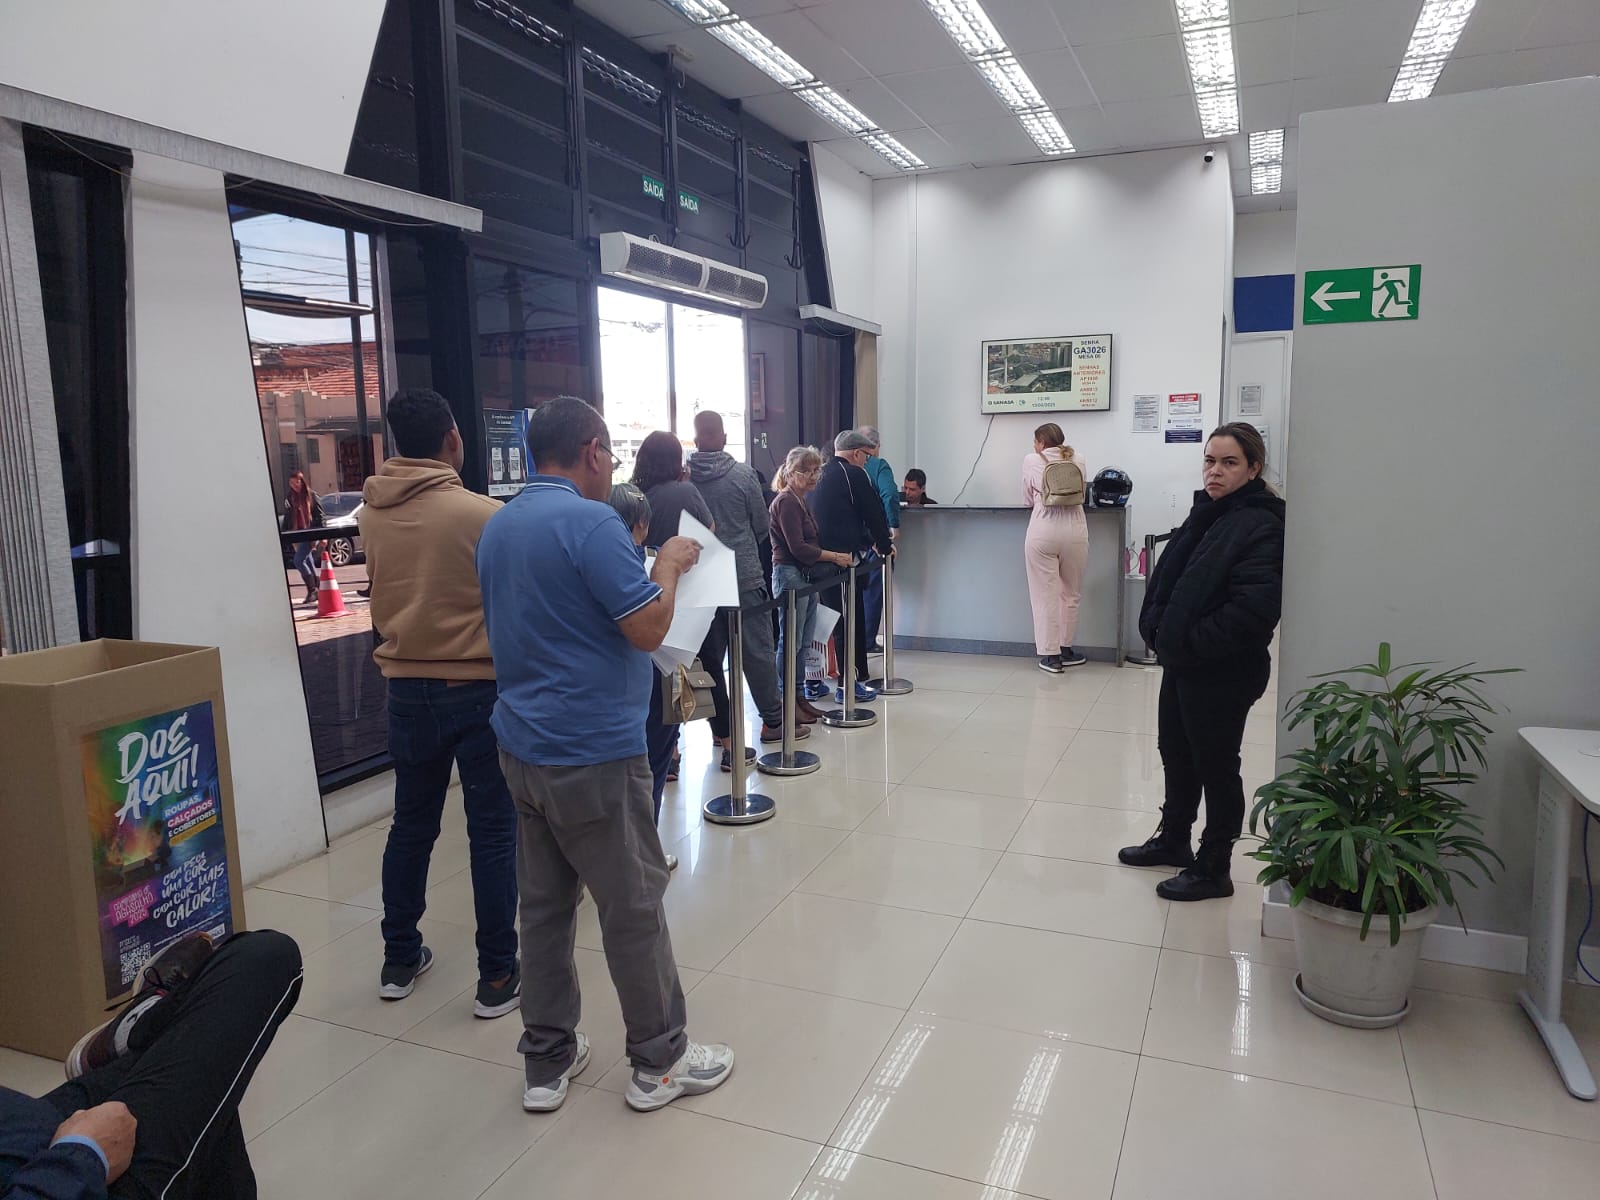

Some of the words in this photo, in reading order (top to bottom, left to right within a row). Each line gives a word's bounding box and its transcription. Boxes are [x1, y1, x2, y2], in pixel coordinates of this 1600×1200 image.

[643, 180, 665, 202] SAÍDA
[1073, 346, 1107, 354] GA3026
[115, 712, 190, 784] DOE
[115, 743, 199, 825] AQUI!
[167, 799, 213, 827] CALÇADOS
[168, 830, 173, 838] E
[173, 808, 216, 835] COBERTORES
[162, 879, 182, 899] UMA
[173, 882, 198, 905] COR
[199, 862, 225, 890] MAIS
[115, 892, 154, 922] AGASALHO
[166, 881, 217, 928] CALOR!
